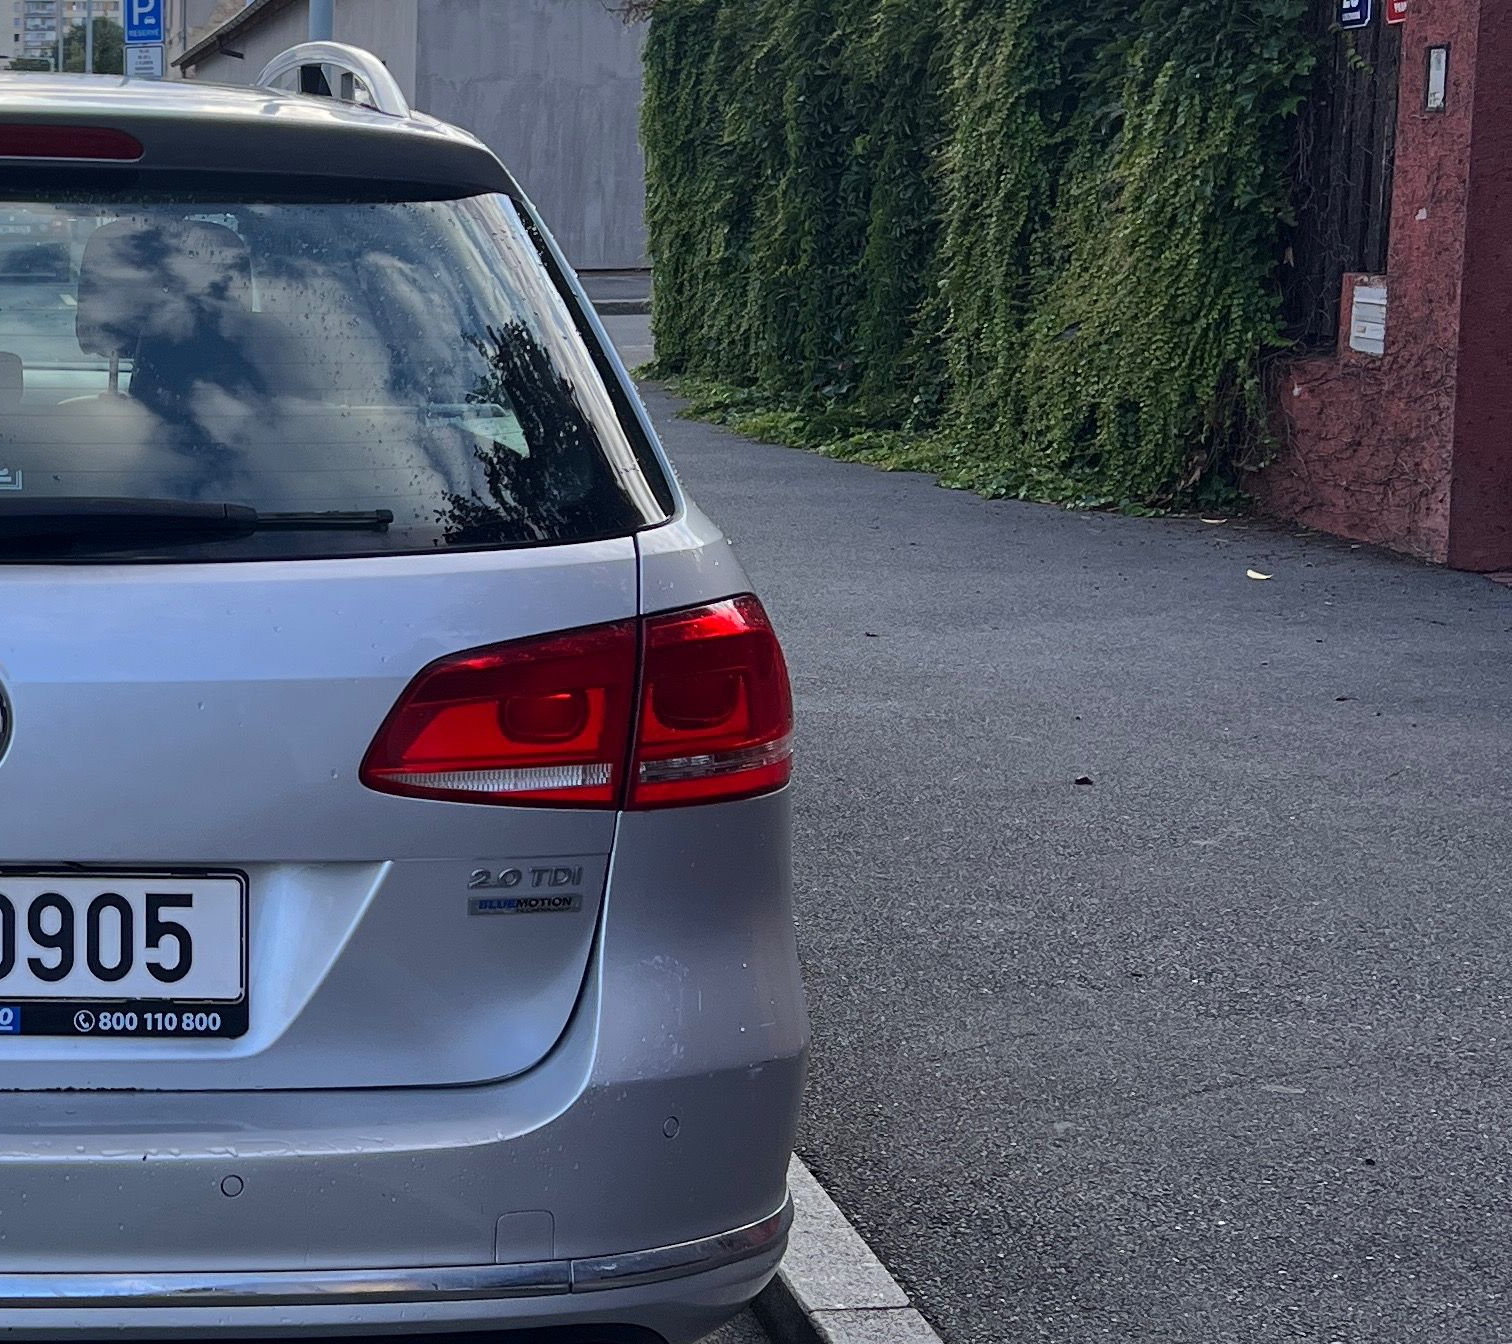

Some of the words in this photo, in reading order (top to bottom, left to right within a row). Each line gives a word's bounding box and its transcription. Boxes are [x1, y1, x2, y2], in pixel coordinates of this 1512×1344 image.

[467, 867, 522, 889] 2.0
[528, 864, 584, 888] TDI
[98, 1012, 138, 1031] 800
[144, 1012, 178, 1031] 110
[182, 1012, 222, 1031] 800
